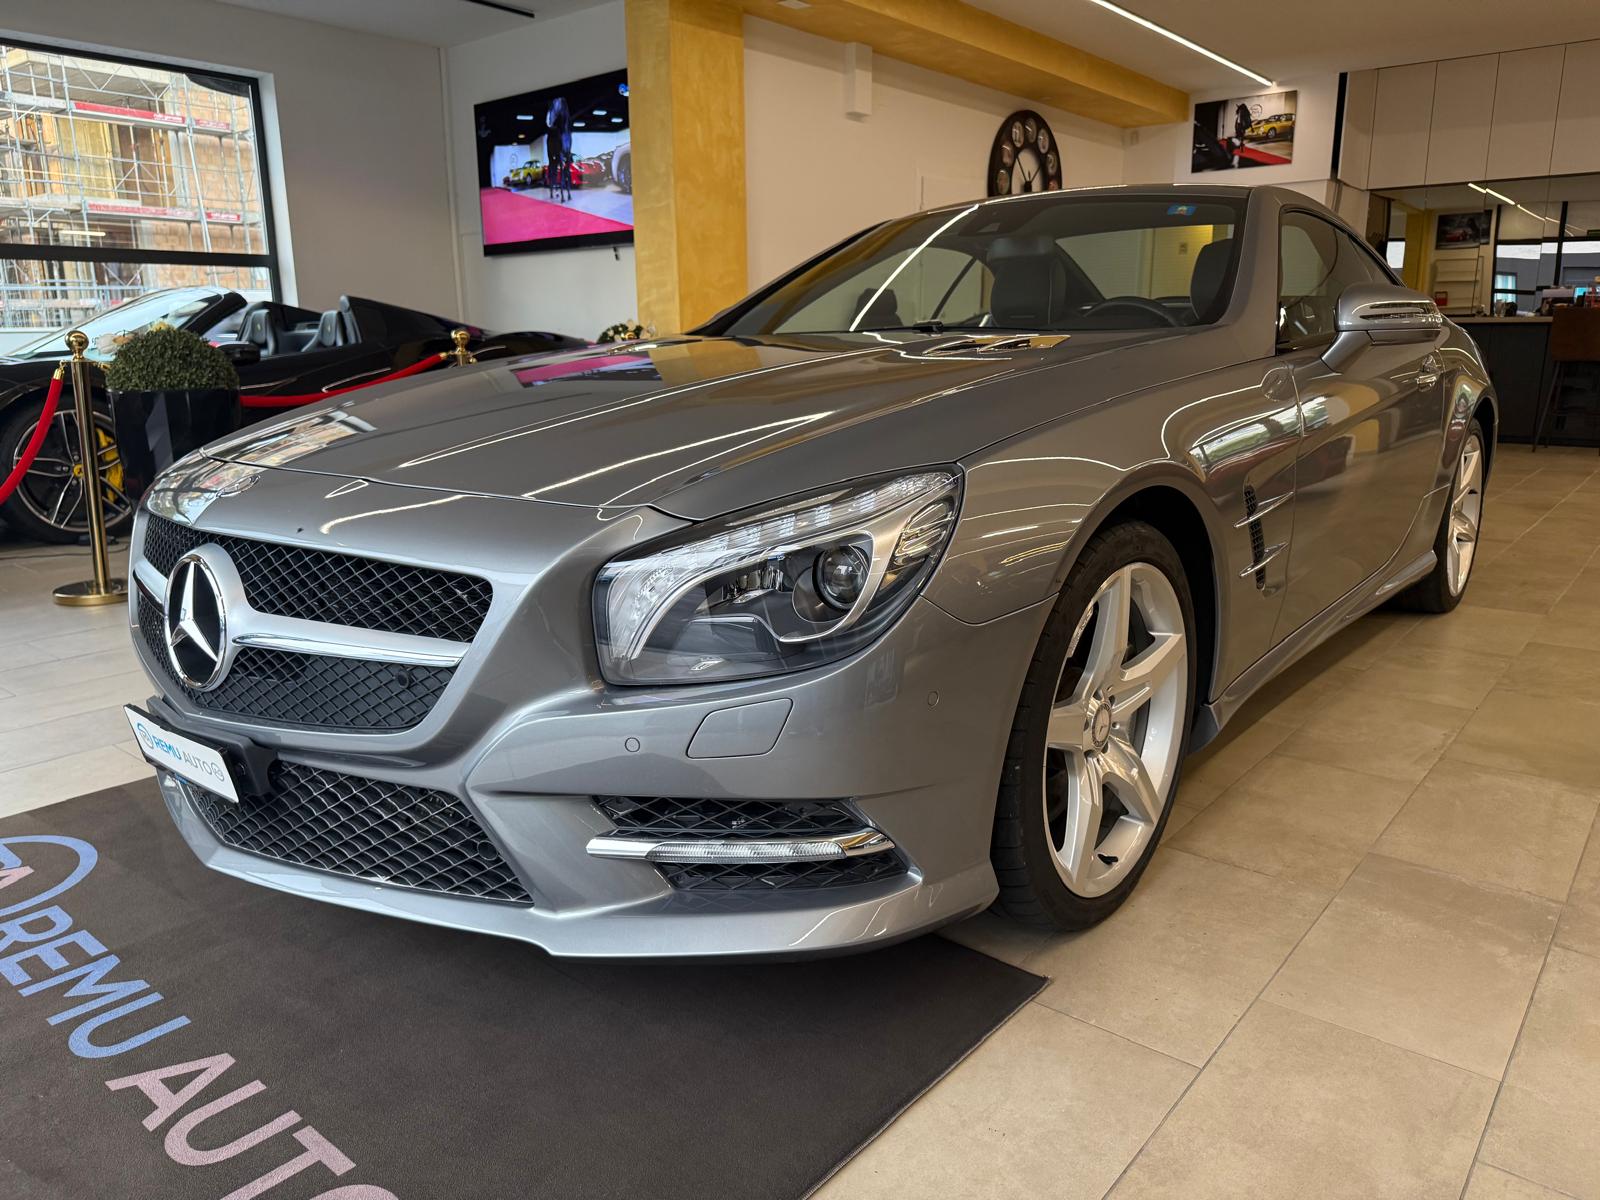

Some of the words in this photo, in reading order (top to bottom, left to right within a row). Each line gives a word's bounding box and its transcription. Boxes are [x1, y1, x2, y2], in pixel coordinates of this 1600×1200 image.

[152, 735, 182, 760] REMU
[183, 751, 212, 775] AUTO
[0, 904, 191, 1059] REMU
[104, 1052, 399, 1200] AUT
